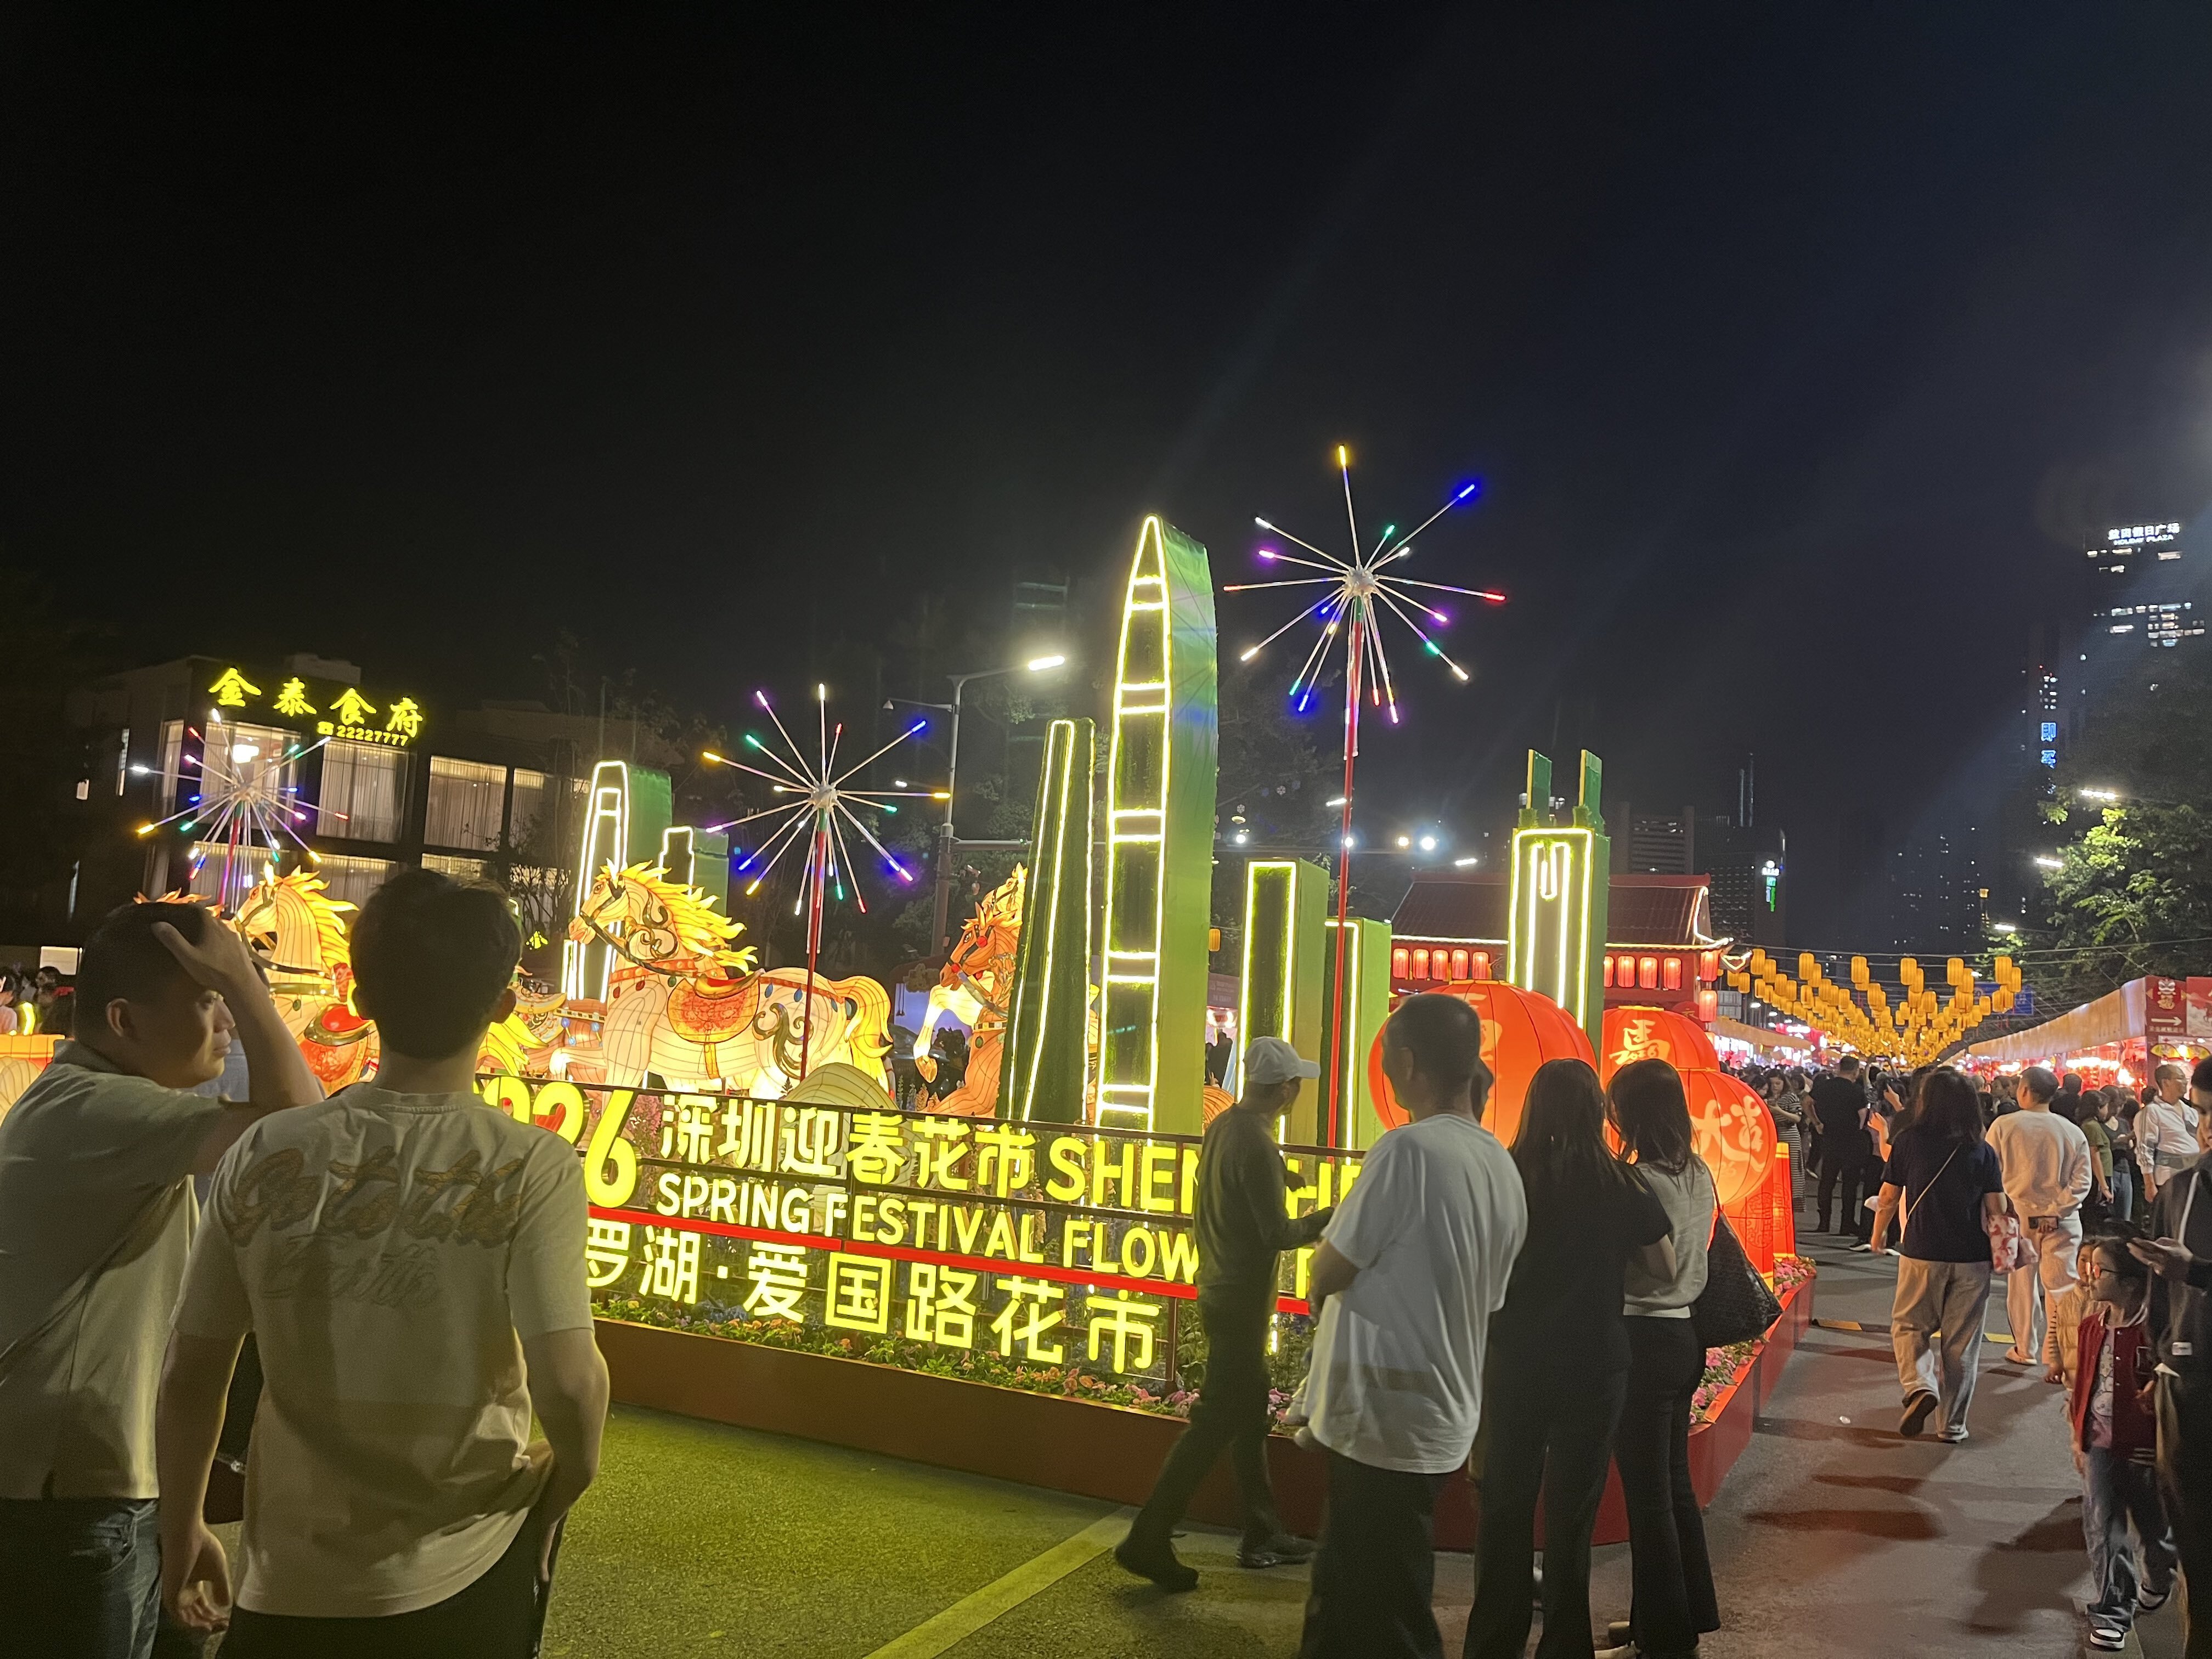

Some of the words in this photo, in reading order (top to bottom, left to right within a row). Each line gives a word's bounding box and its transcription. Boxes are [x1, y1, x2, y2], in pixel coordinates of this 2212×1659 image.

[208, 668, 423, 737] 金泰食府
[337, 725, 408, 746] 22227777
[660, 1094, 1037, 1199] 深圳迎春花市
[656, 1172, 810, 1234] SPRING
[825, 1192, 1045, 1264] FESTIVAL
[1063, 1220, 1199, 1284] FLOW
